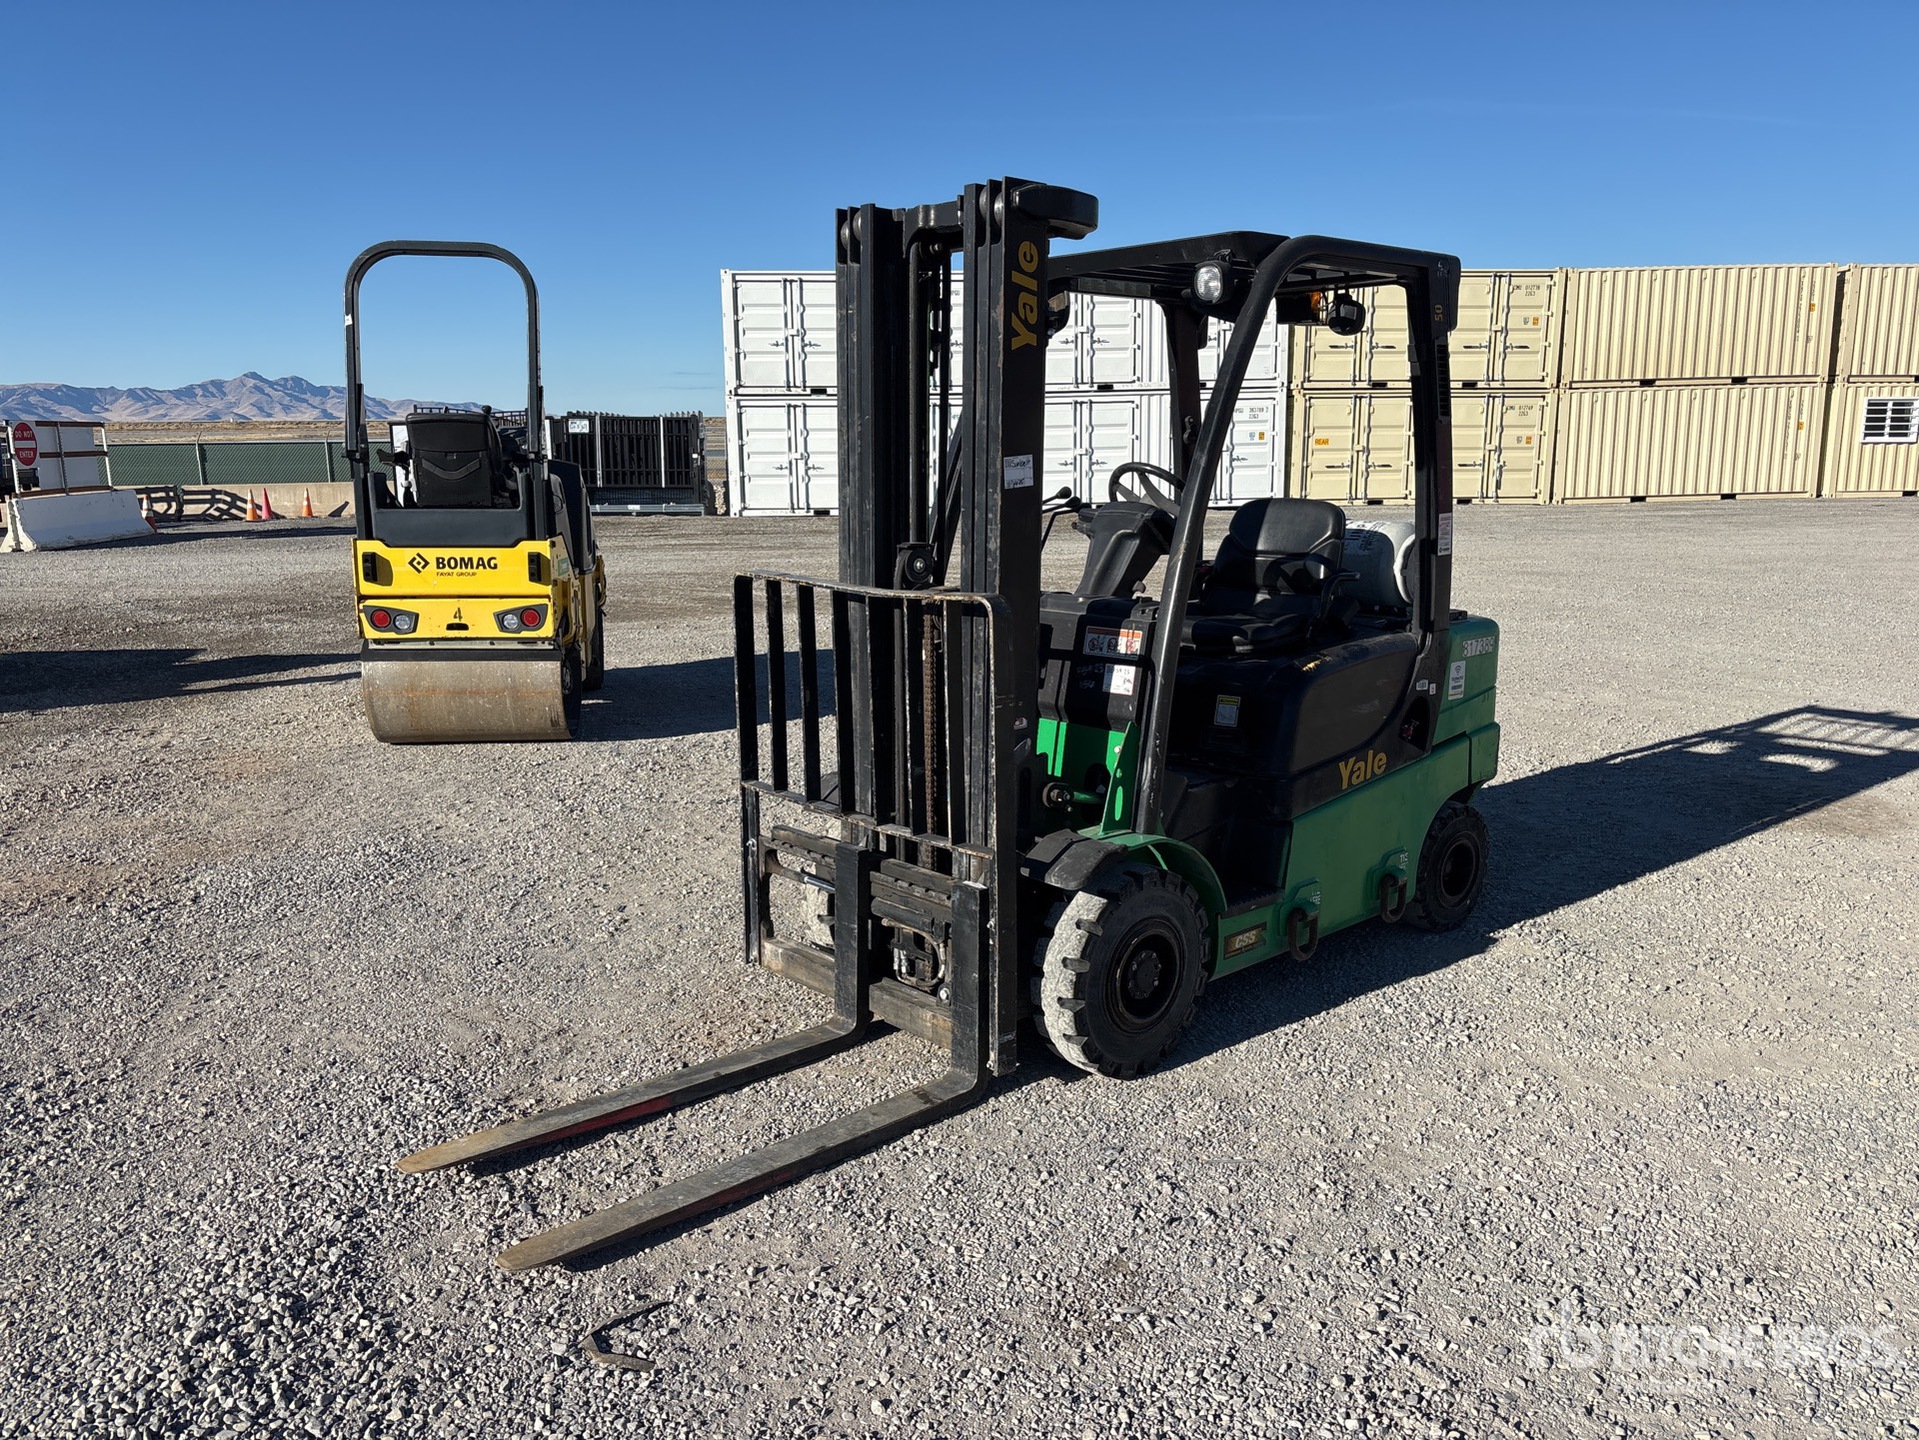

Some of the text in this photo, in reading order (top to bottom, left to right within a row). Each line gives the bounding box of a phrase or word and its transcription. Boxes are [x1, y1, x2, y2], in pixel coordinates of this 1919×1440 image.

[1011, 240, 1039, 350] Yale
[15, 430, 33, 438] DO NOT
[20, 451, 34, 459] ENTER
[435, 556, 498, 570] BOMAG
[1339, 750, 1387, 790] Yale
